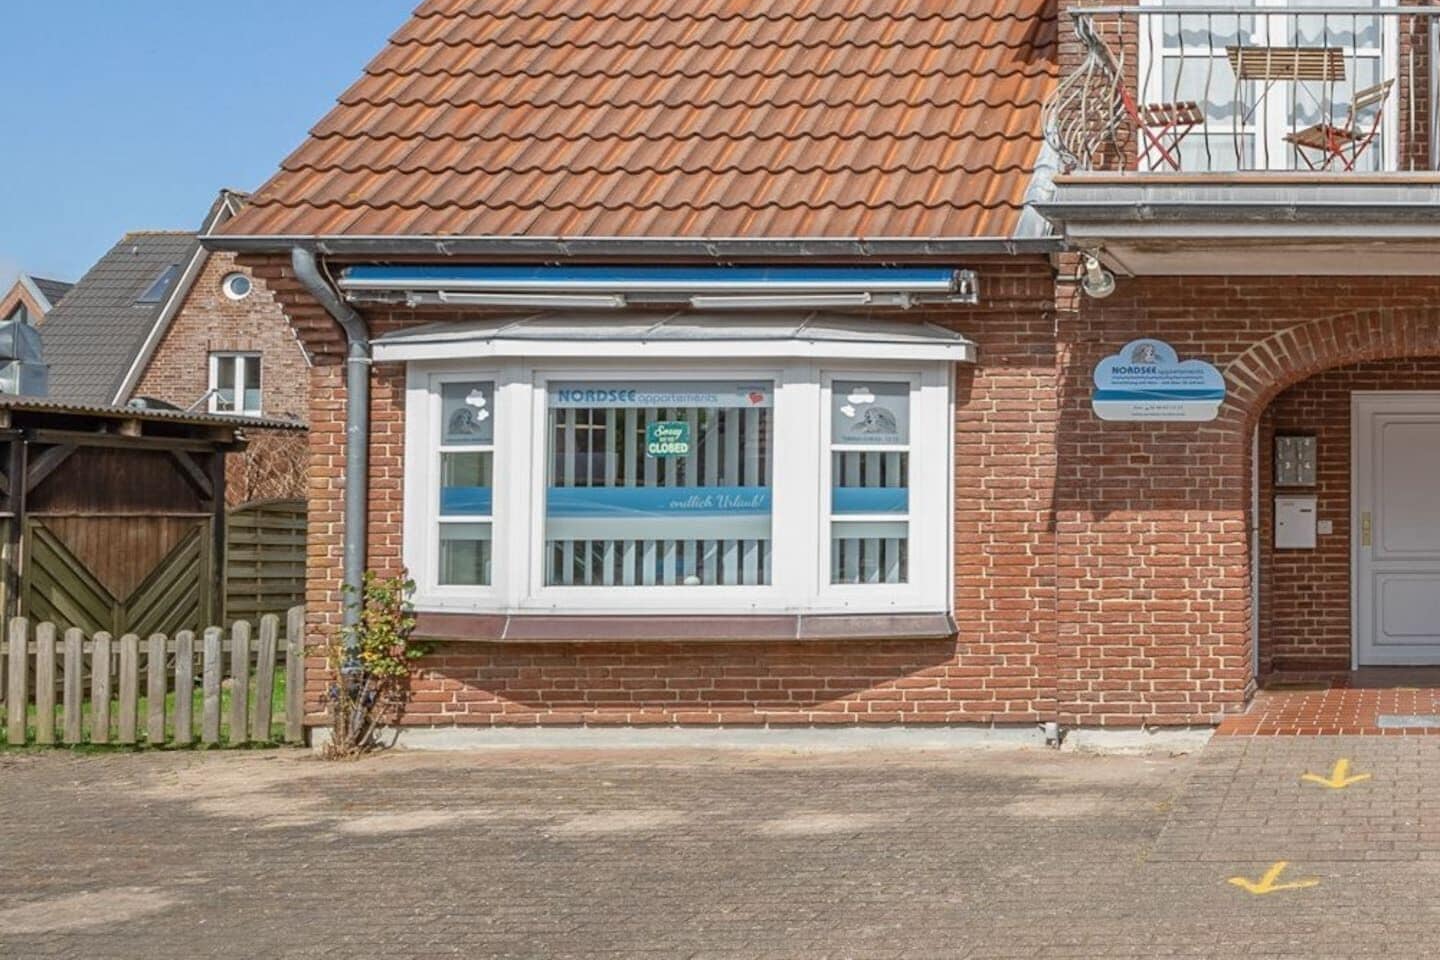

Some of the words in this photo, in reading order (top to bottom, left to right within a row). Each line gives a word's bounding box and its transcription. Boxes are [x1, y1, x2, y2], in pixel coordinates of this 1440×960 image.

[1112, 366, 1157, 375] NORDSEE
[558, 389, 636, 402] NORDSEE
[649, 442, 689, 453] CLOSED
